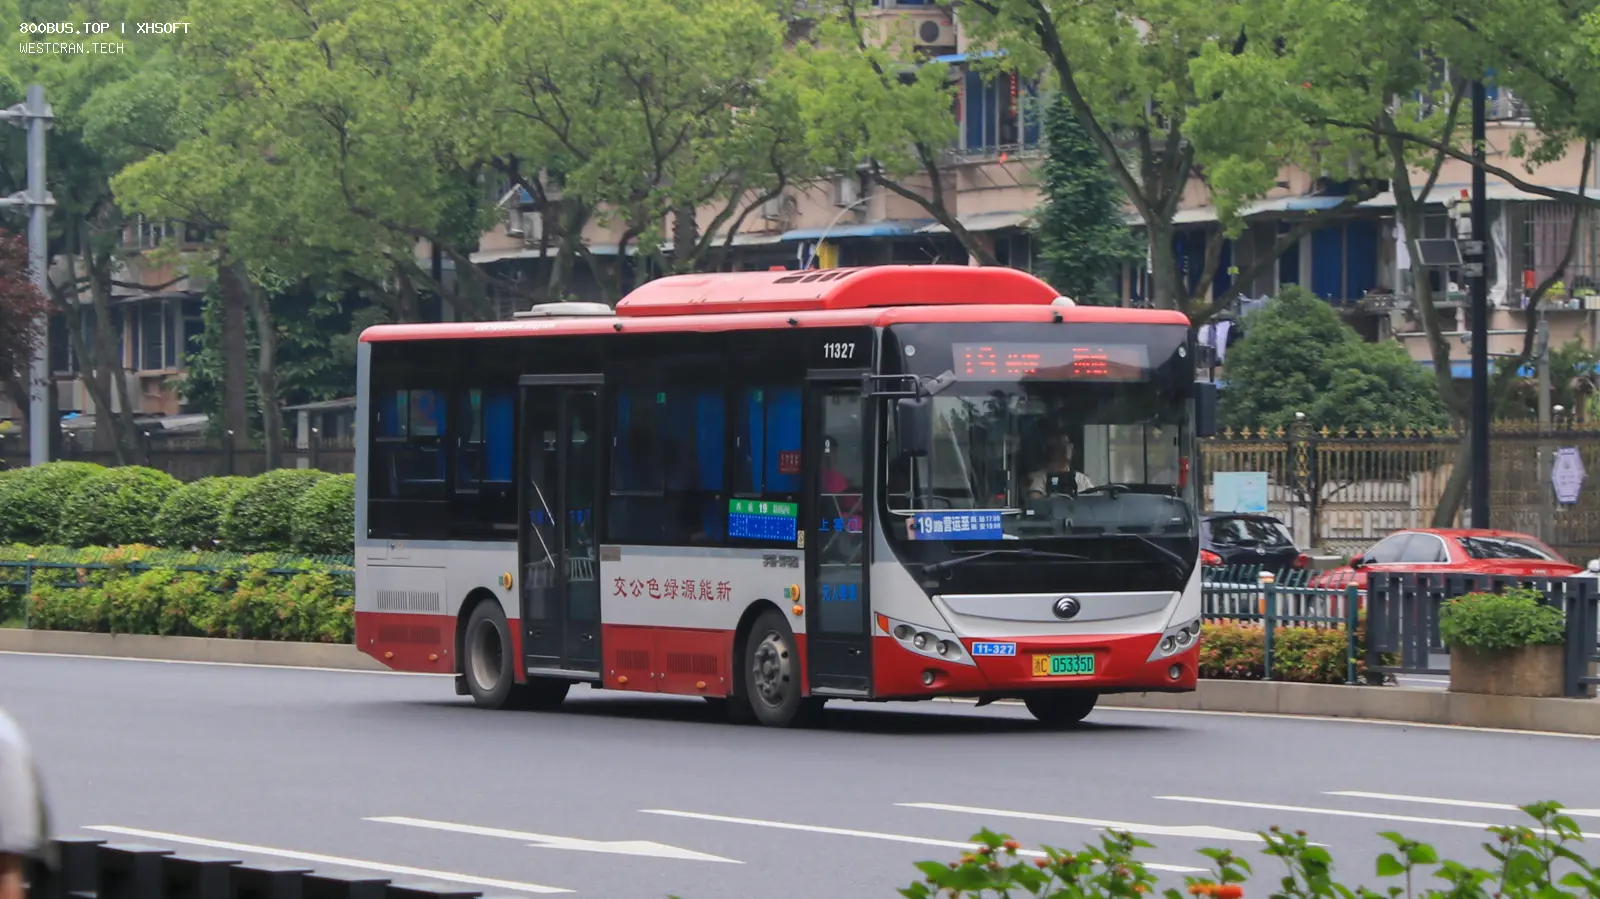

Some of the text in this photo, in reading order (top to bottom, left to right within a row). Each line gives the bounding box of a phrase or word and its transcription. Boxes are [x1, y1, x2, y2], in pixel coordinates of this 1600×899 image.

[823, 342, 855, 359] 11327
[759, 502, 768, 514] 19
[976, 644, 1014, 656] 11-327
[1052, 656, 1094, 673] 05335D
